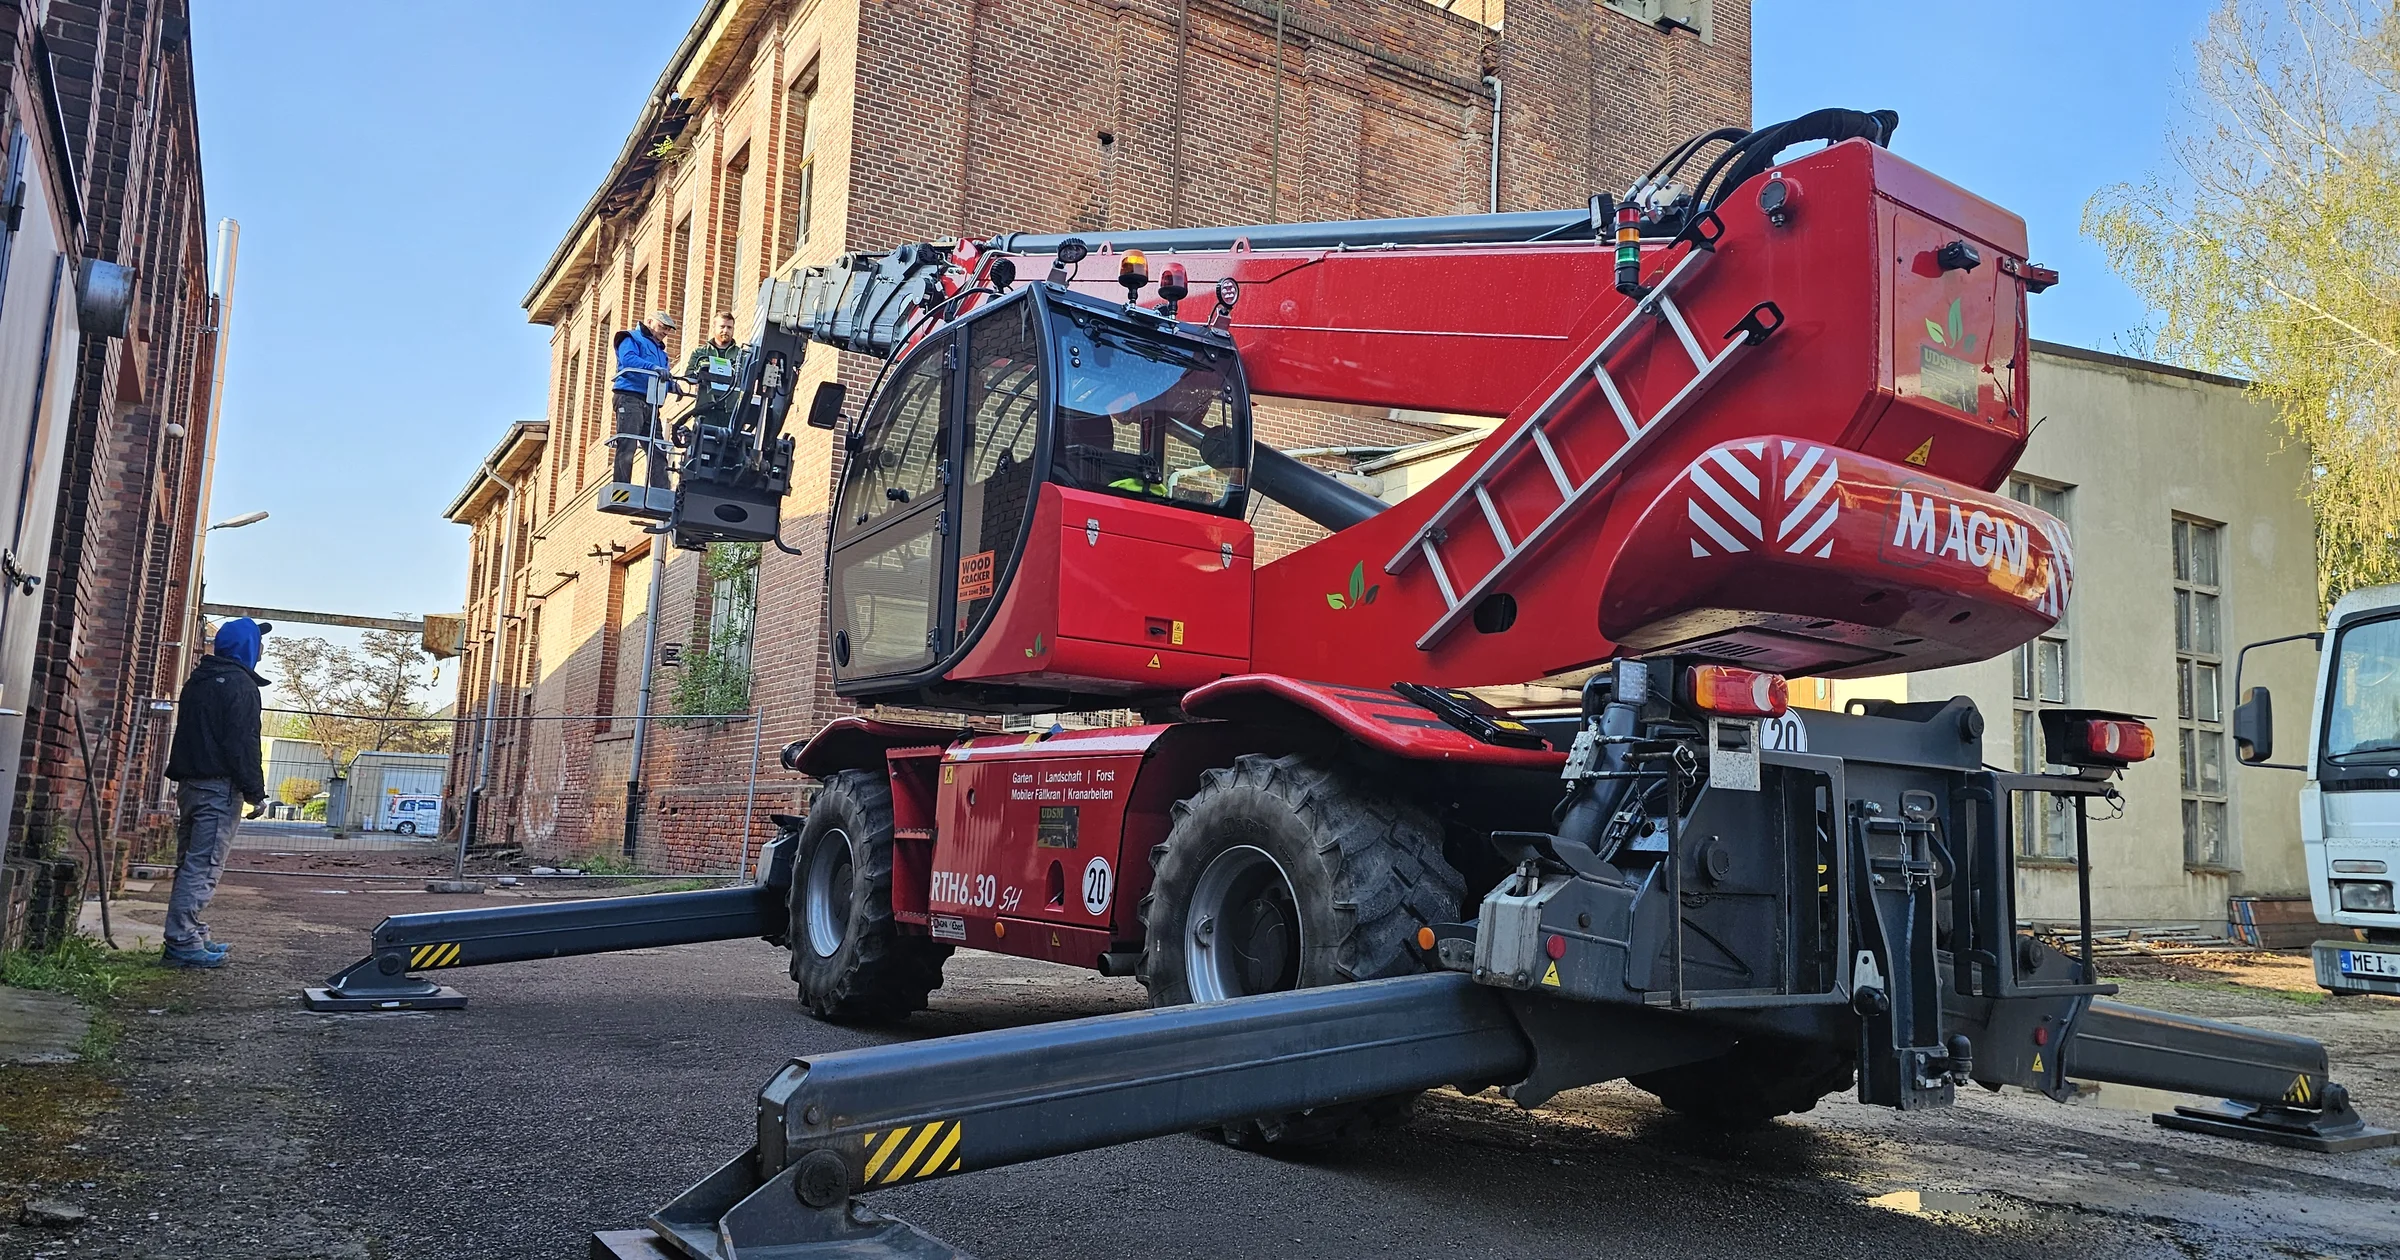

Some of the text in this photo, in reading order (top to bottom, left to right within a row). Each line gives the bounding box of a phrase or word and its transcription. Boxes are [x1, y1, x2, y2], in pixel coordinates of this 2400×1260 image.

[1893, 491, 2029, 578] MAGNI
[962, 556, 991, 574] WOOD
[961, 571, 990, 585] CRACKER
[1771, 717, 1797, 752] 20
[1012, 772, 1033, 783] Garten
[1045, 769, 1082, 783] Landschaft
[1096, 769, 1115, 781] Forst
[1011, 788, 1034, 800] Mobiler
[1035, 788, 1061, 800] Fällkran
[1067, 787, 1113, 800] Kranarbeiten
[1041, 807, 1064, 818] UDSM
[930, 871, 1023, 912] RTH6.30 SH
[1087, 867, 1106, 904] 20
[2352, 954, 2384, 973] MEI
